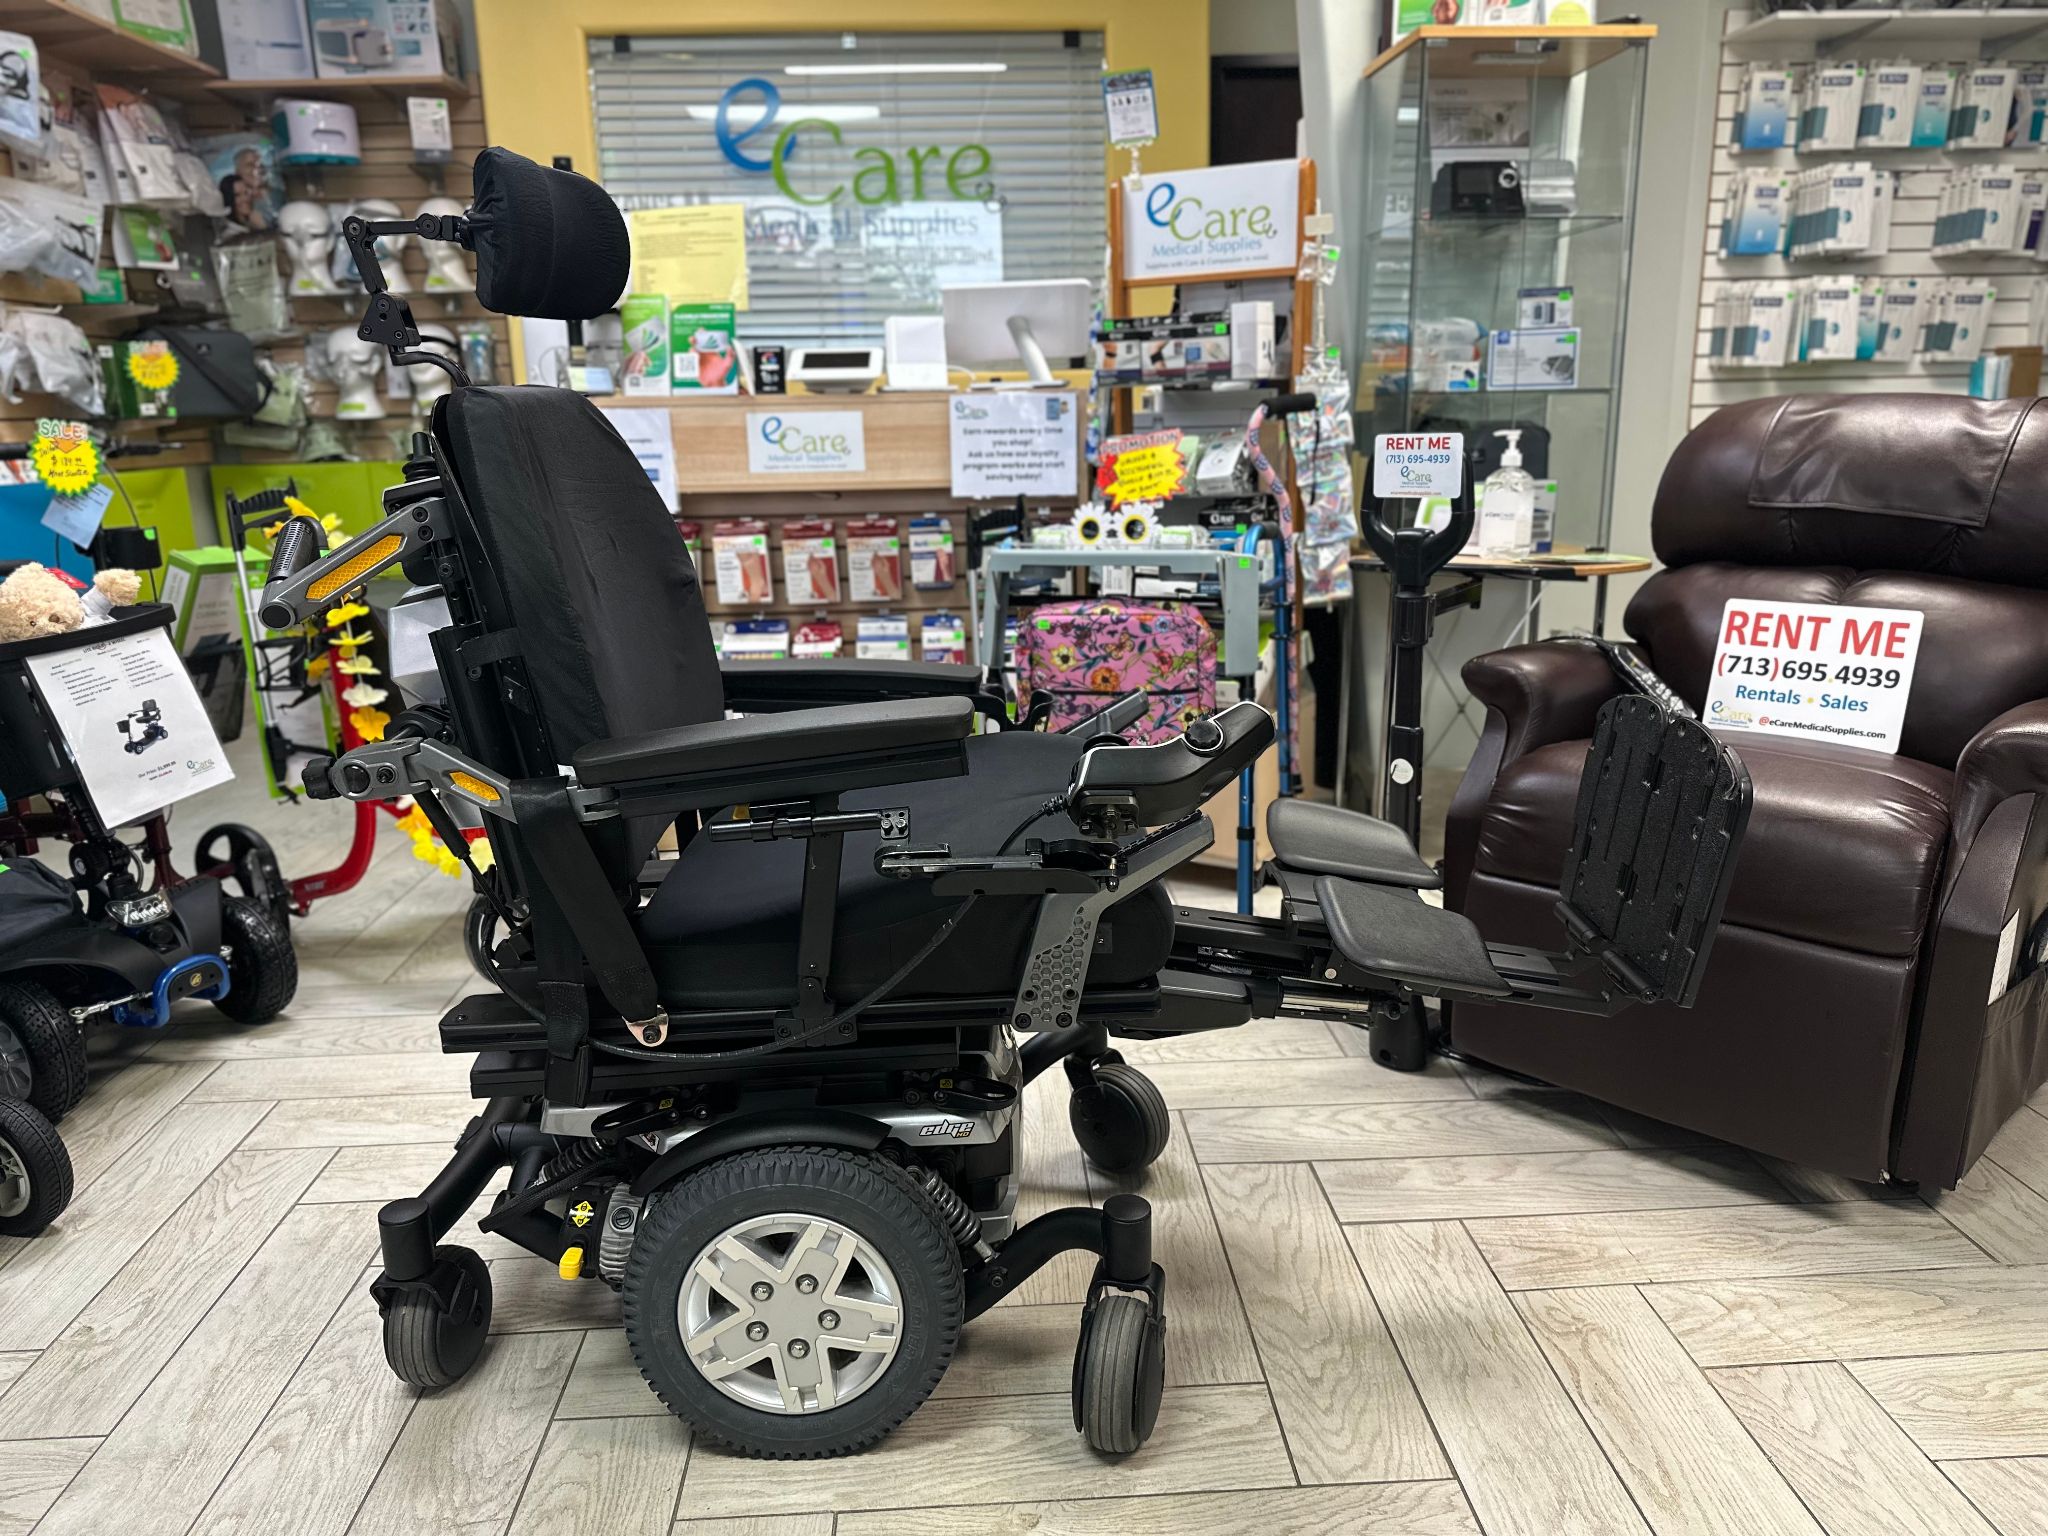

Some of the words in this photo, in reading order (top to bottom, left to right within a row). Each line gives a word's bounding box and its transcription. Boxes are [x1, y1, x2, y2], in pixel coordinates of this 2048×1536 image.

[715, 78, 992, 205] eCare
[1146, 182, 1271, 242] eCare
[1152, 241, 1203, 257] Medical
[1208, 237, 1263, 255] Supplies
[762, 416, 846, 455] eCare
[963, 428, 982, 436] Earn
[983, 426, 1017, 435] rewards
[1019, 427, 1042, 437] every
[1044, 426, 1063, 434] time
[992, 440, 1008, 448] you
[1102, 433, 1178, 452] PROMOTION
[1386, 437, 1424, 450] RENT
[1428, 437, 1451, 450] ME
[968, 450, 982, 458] Ask
[996, 450, 1013, 458] how
[1030, 449, 1059, 460] loyalty
[1386, 454, 1405, 464] (713)
[1407, 454, 1450, 463] 695-4939
[962, 463, 999, 472] program
[1001, 461, 1025, 470] works
[1027, 460, 1043, 469] and
[1045, 461, 1064, 469] start
[1401, 466, 1431, 482] eCare
[985, 473, 1013, 483] saving
[1015, 472, 1042, 483] today!
[1724, 610, 1831, 652] RENT
[1840, 618, 1911, 659] ME
[1736, 685, 1801, 705] Rentals
[1819, 693, 1869, 712] Sales
[1711, 700, 1753, 721] eCare
[1759, 716, 1886, 739] @eCareMedicalSupplies.com
[919, 1119, 975, 1138] edge
